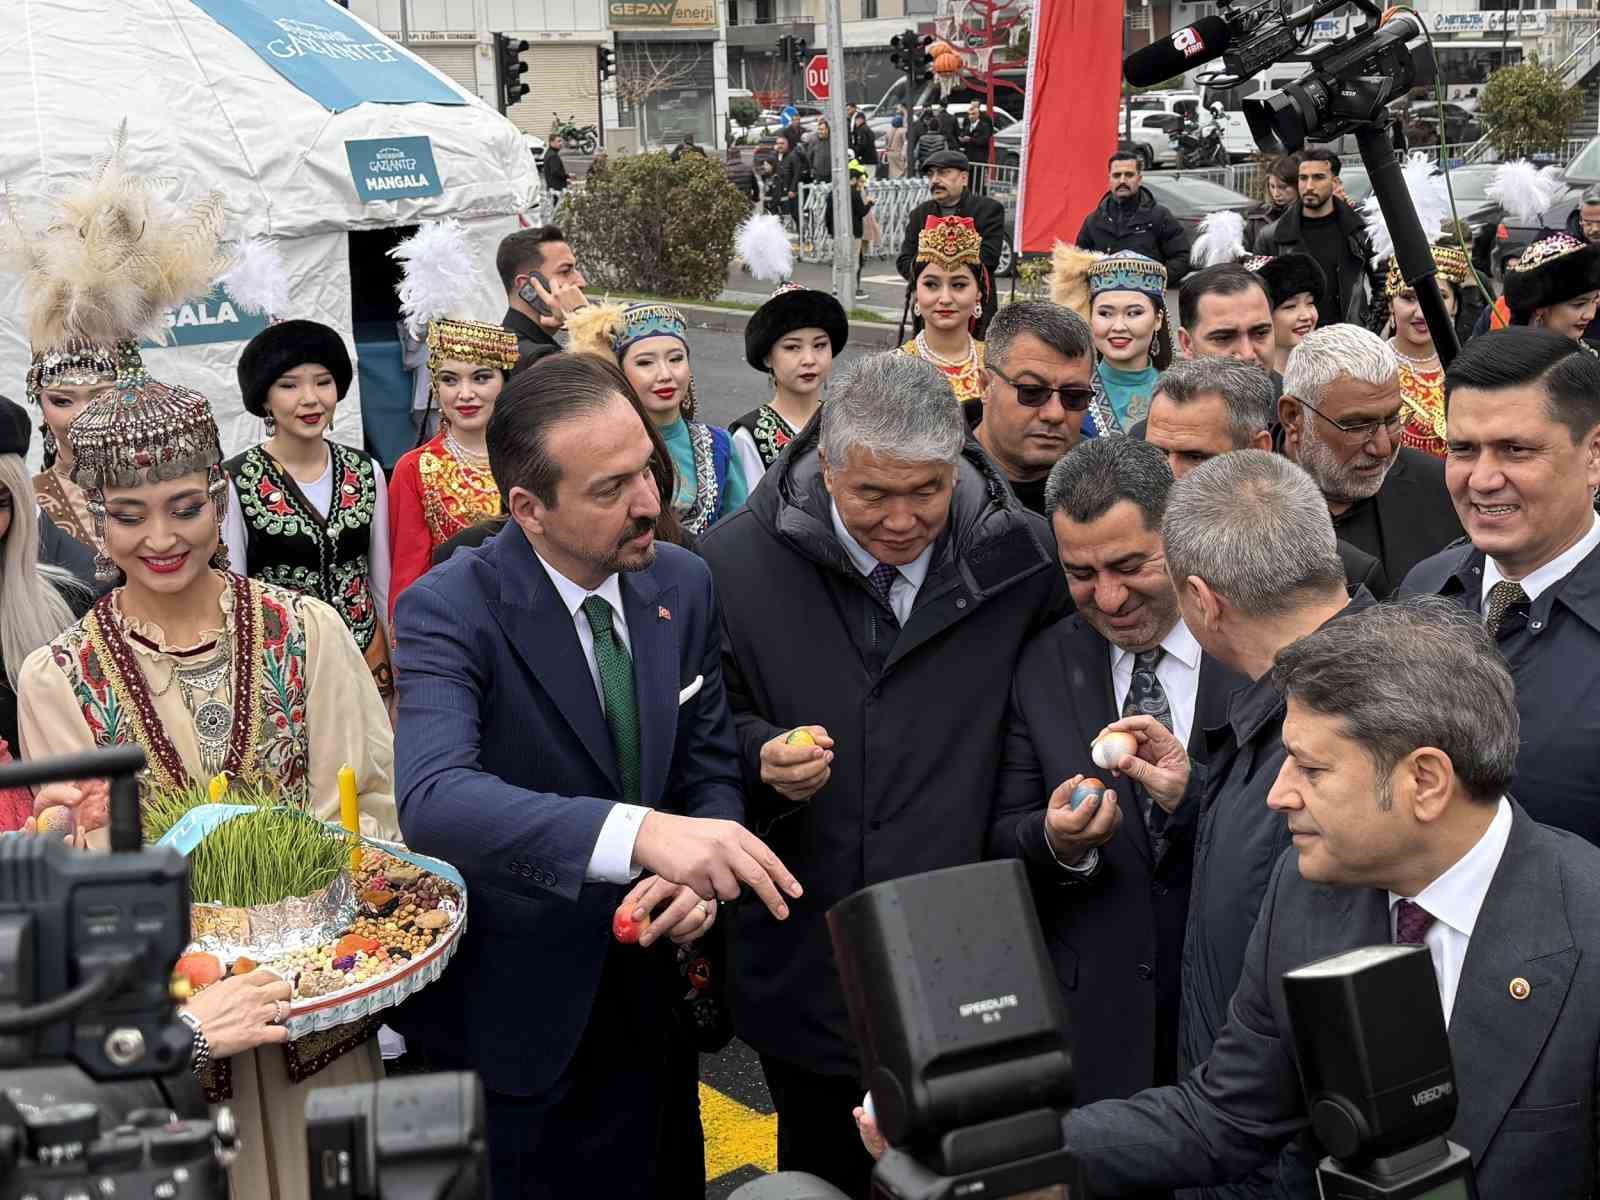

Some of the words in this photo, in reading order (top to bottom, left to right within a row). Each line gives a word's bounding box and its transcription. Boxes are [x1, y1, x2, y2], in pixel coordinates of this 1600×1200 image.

[610, 3, 672, 15] GEPAY
[675, 6, 713, 21] enerji
[809, 69, 828, 87] DU
[365, 173, 430, 192] MANGALA
[162, 301, 239, 329] GALA
